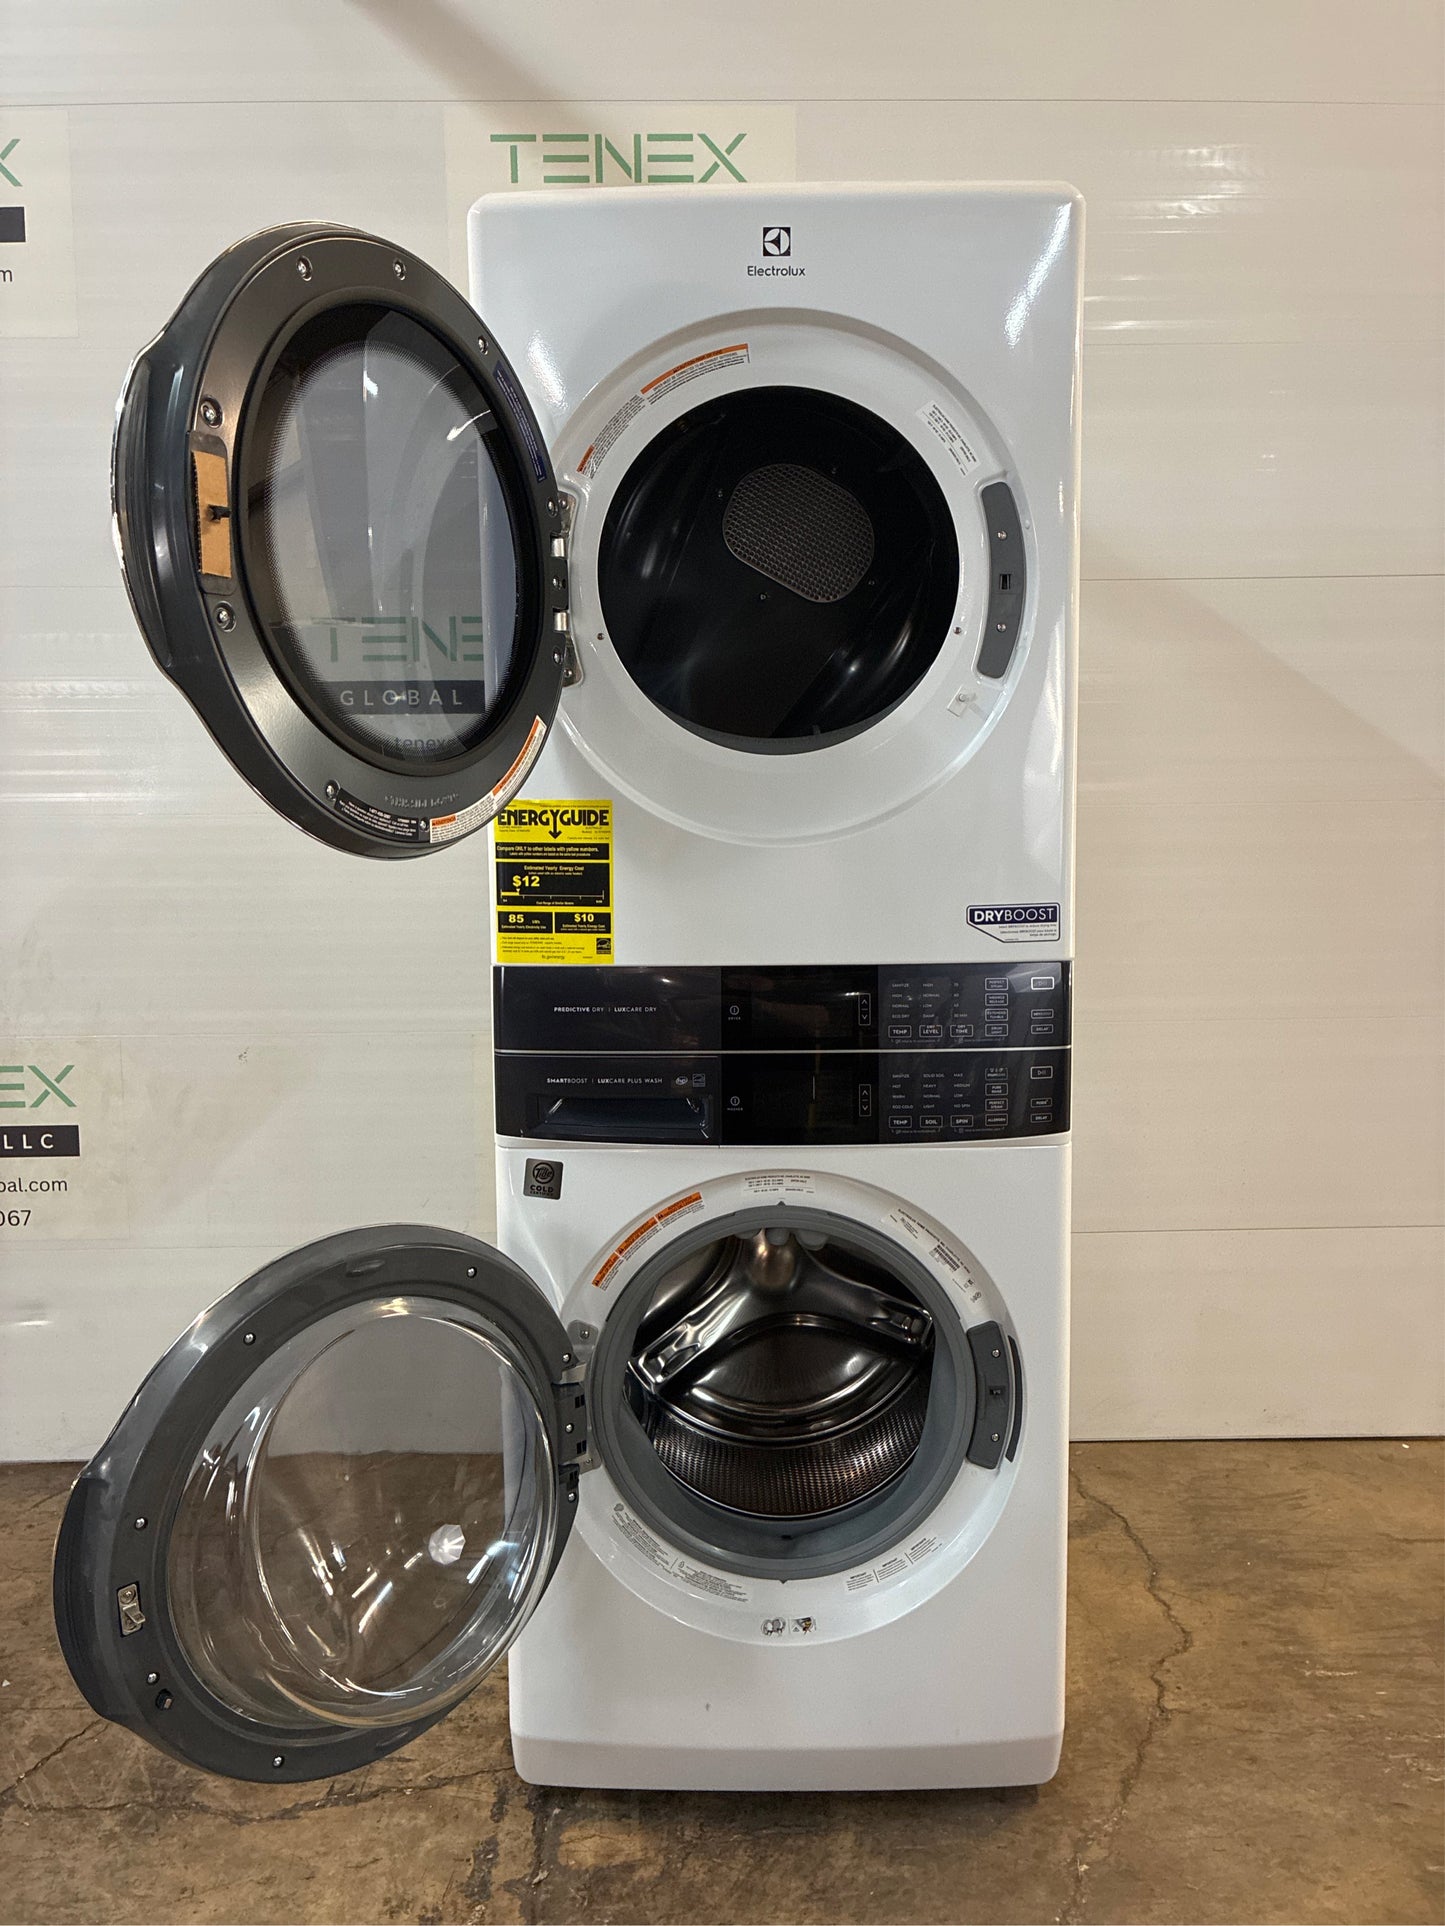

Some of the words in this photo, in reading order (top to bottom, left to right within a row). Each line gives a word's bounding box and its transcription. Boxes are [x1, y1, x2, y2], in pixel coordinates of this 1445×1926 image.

[490, 133, 747, 184] TENEX
[747, 265, 806, 277] Electrolux
[340, 689, 463, 706] GLOBAL
[498, 809, 610, 832] ENERGYGUIDE
[566, 846, 579, 854] yellow
[512, 875, 540, 887] $12
[508, 914, 525, 923] 85
[574, 913, 594, 923] $10
[974, 908, 1054, 923] DRYBOOST
[3, 1134, 54, 1150] LLC
[535, 1166, 553, 1179] Tide
[530, 1184, 554, 1193] COLD
